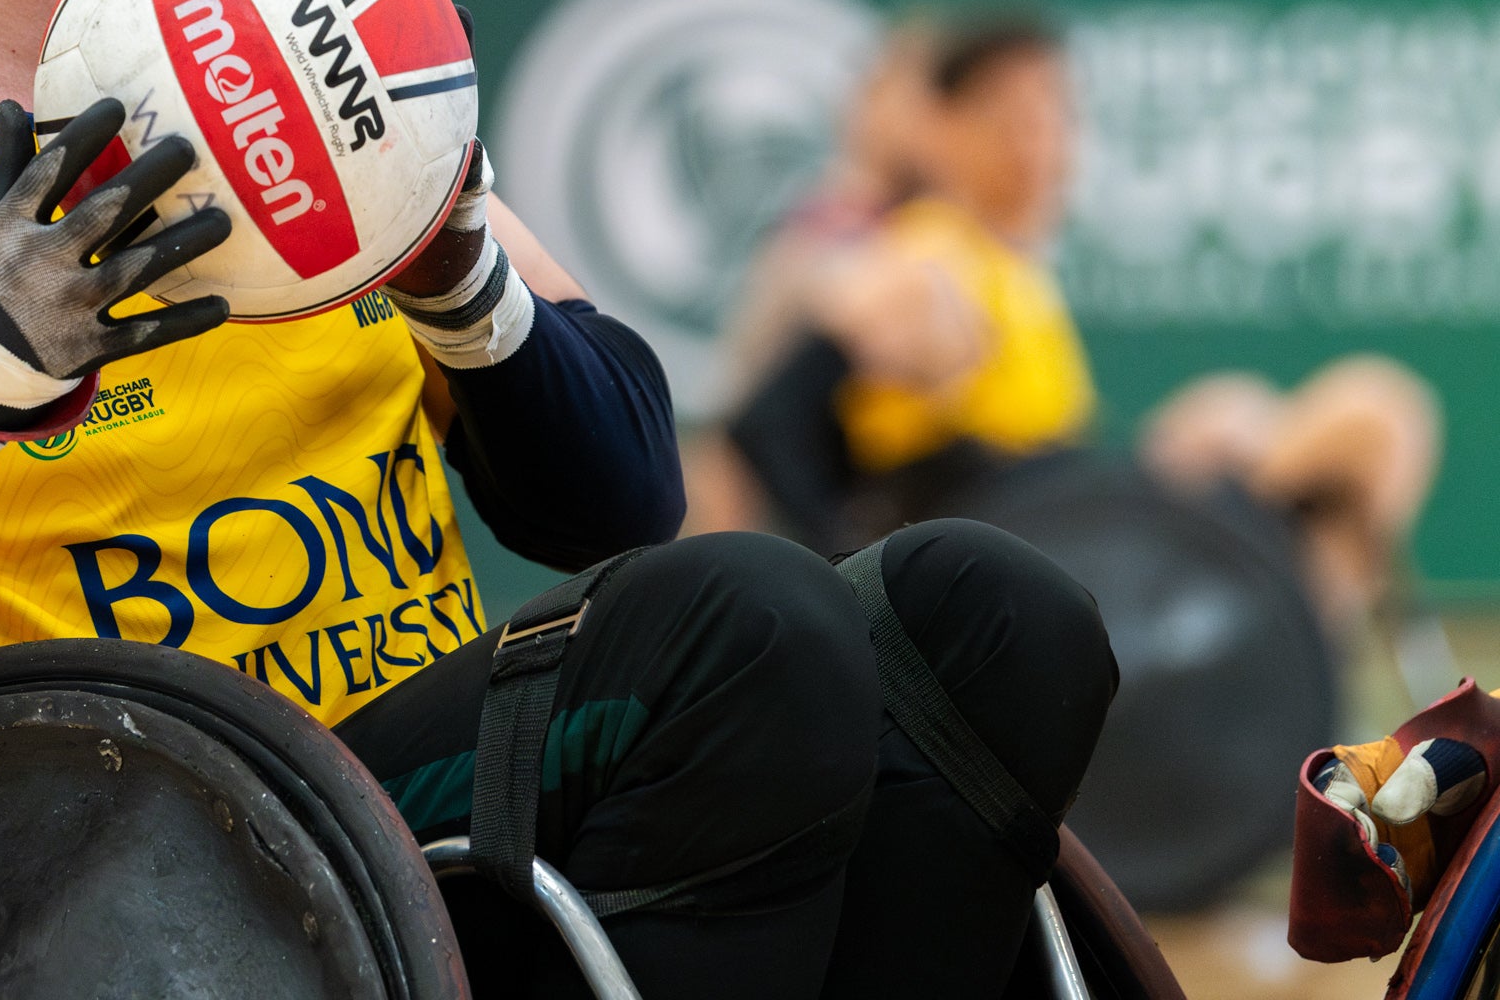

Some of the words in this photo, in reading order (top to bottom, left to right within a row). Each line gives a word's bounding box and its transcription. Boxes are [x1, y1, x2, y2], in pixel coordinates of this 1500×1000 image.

[285, 32, 308, 65] World
[303, 60, 335, 124] Wheelchair
[329, 121, 346, 158] Rugby
[82, 389, 154, 427] RUGBY
[85, 419, 130, 436] NATIONAL
[132, 408, 165, 423] LEAGUE
